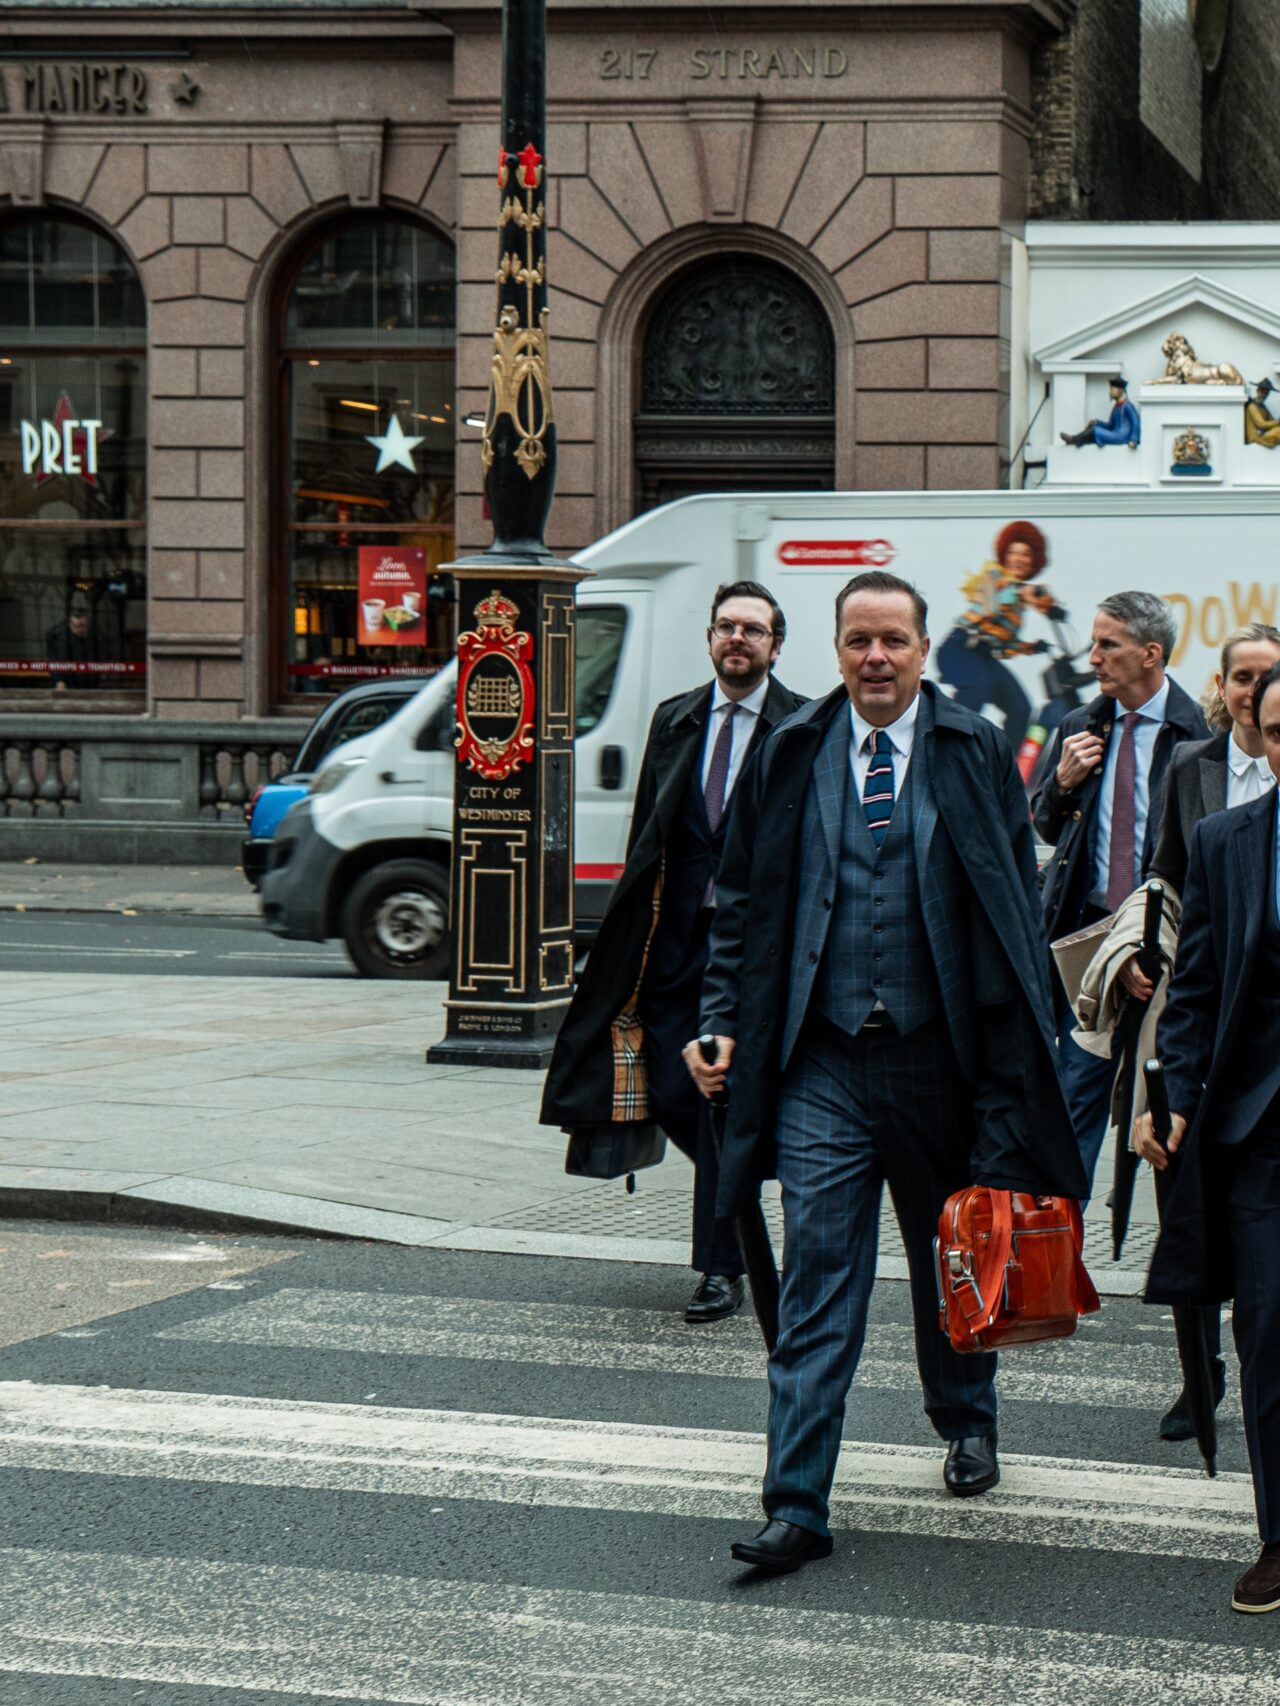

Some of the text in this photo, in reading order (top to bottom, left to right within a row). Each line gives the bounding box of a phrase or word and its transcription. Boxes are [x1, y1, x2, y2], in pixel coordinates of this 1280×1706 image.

[599, 47, 849, 80] 217 STRAND
[22, 64, 148, 115] MANGER
[20, 418, 103, 475] PRET
[469, 786, 522, 800] CITY OF
[458, 807, 532, 822] WESTMINSTER
